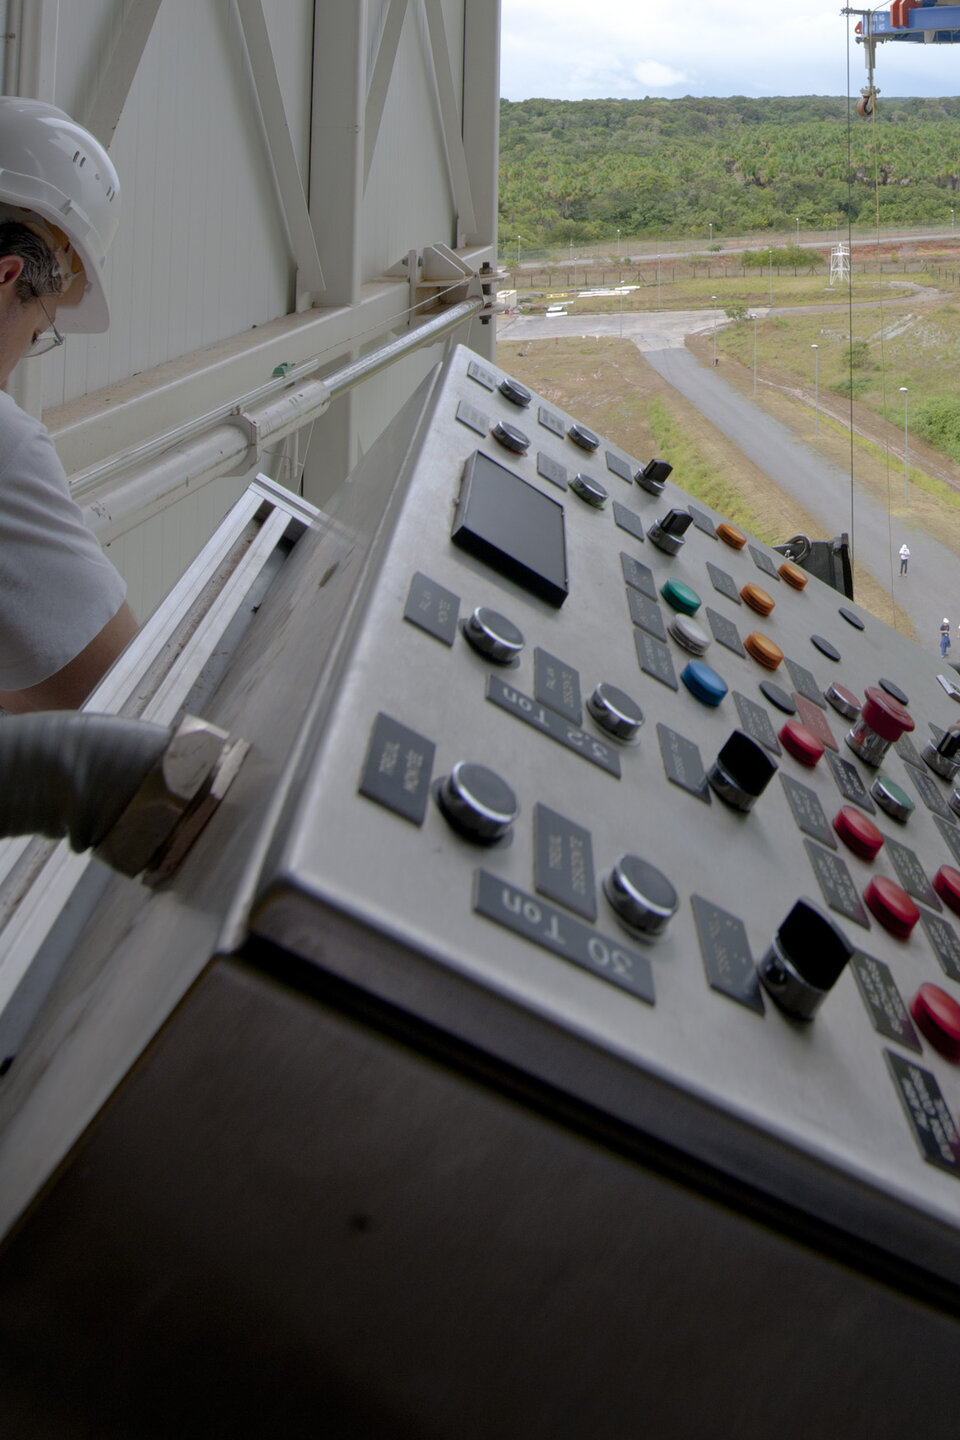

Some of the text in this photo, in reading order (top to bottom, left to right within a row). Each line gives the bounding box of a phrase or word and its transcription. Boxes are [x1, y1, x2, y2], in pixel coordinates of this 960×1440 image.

[502, 688, 549, 727] Ton
[566, 726, 609, 764] 3.2
[502, 889, 633, 982] 30 Ton
